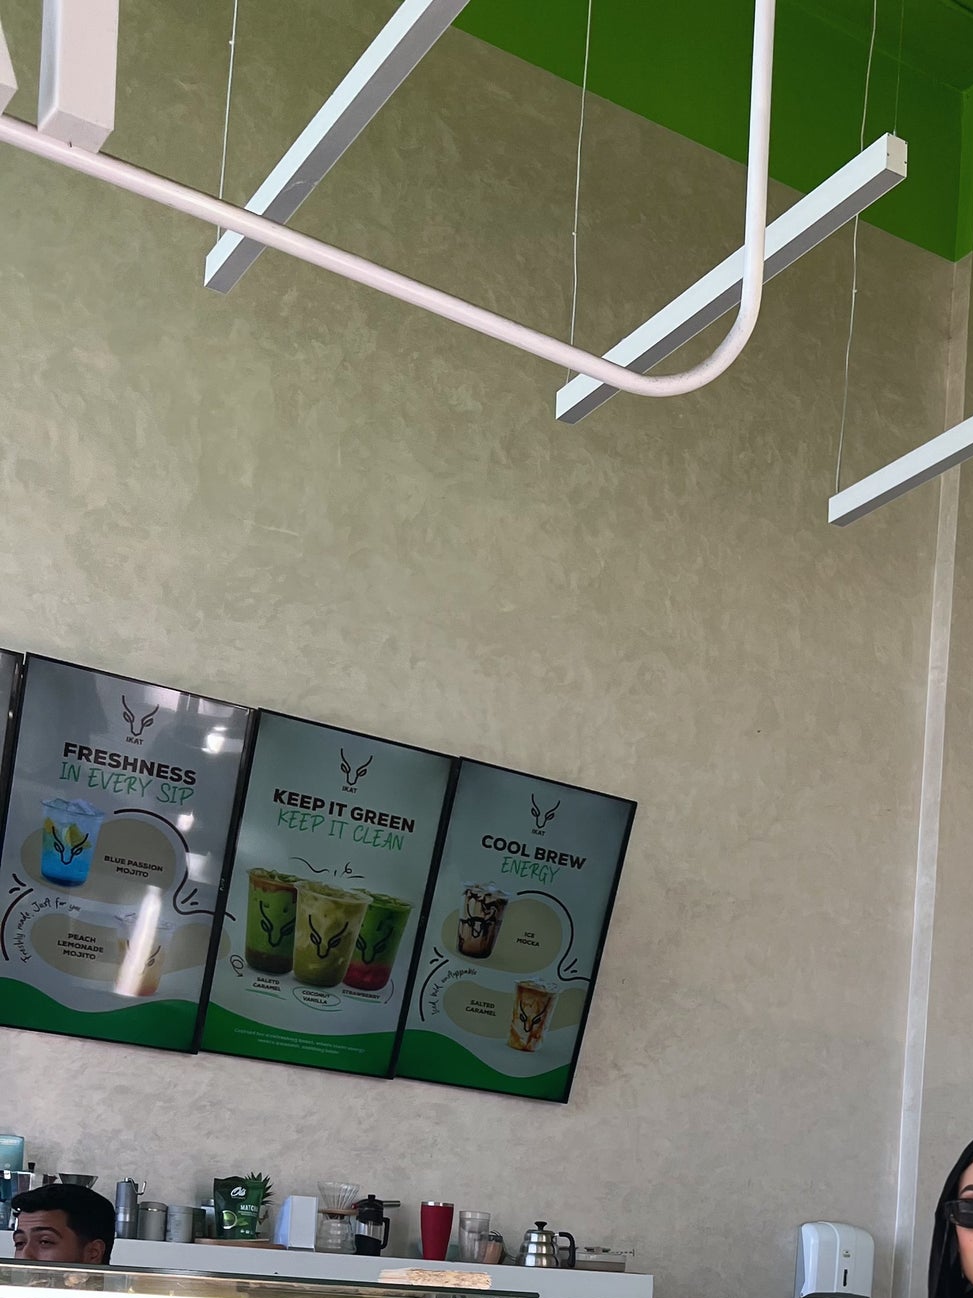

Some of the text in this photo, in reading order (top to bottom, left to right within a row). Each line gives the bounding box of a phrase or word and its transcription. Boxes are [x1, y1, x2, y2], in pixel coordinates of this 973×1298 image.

[126, 737, 144, 745] IKAT
[63, 741, 197, 785] FRESHNESS
[59, 761, 195, 806] IN EVERY SIP
[342, 785, 358, 794] IKAT
[273, 788, 415, 833] KEEP IT GREEN
[277, 808, 405, 851] KEEP IT CLEAN
[481, 834, 586, 870] COOL BREW
[104, 855, 163, 872] BLUE PASSION
[116, 866, 149, 878] MOJITO
[501, 856, 561, 885] ENERGY
[68, 932, 96, 943] PEACH
[57, 939, 104, 953] LEMONADE
[62, 949, 96, 960] MOJITO
[253, 982, 281, 992] CARAMEL
[302, 990, 330, 998] COCONUT
[342, 989, 380, 1000] STRAWBERRY
[303, 996, 328, 1005] VANILLA
[470, 1000, 495, 1009] SALTED
[465, 1006, 497, 1017] CARAMEL
